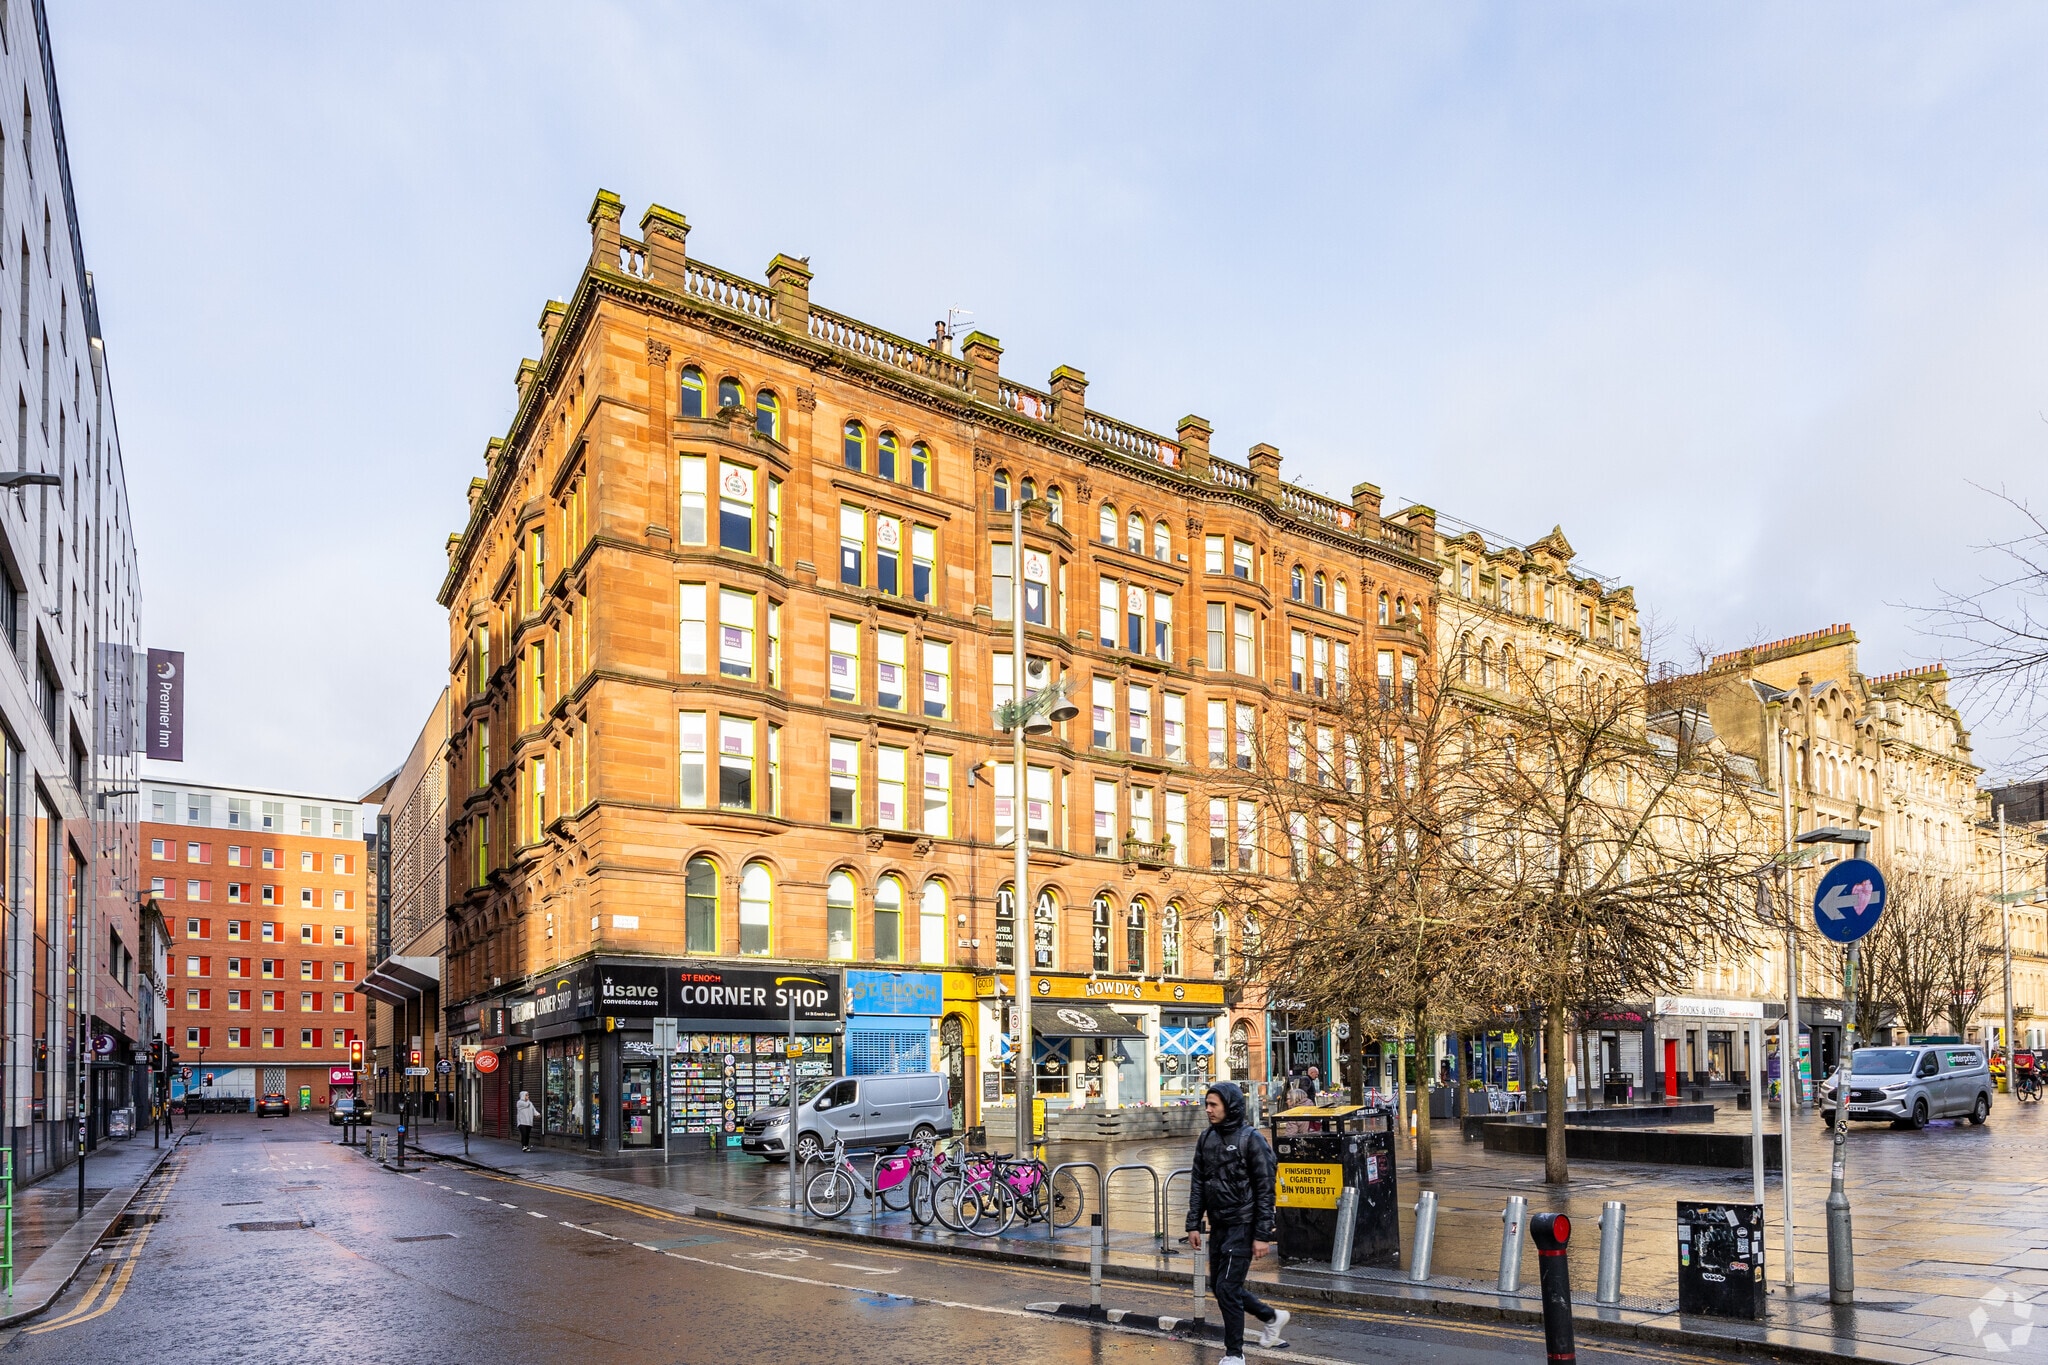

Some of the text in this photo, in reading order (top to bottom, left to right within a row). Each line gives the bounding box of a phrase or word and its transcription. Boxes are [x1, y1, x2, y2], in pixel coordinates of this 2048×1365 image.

[160, 682, 172, 748] Premier Inn
[1036, 894, 1052, 917] A
[693, 974, 721, 983] ENOCH
[952, 979, 965, 990] 60
[978, 980, 992, 988] GOLD
[681, 985, 828, 1008] CORNER SHOP
[854, 982, 936, 1001] ST. ENOCH
[1085, 982, 1142, 999] HOWDY'S
[537, 994, 556, 1016] CORNER
[557, 990, 571, 1010] SHOP
[1680, 1006, 1726, 1015] BOOKS & MEDIA
[1293, 1053, 1319, 1064] VEGAN
[1947, 1053, 1977, 1064] enterprise
